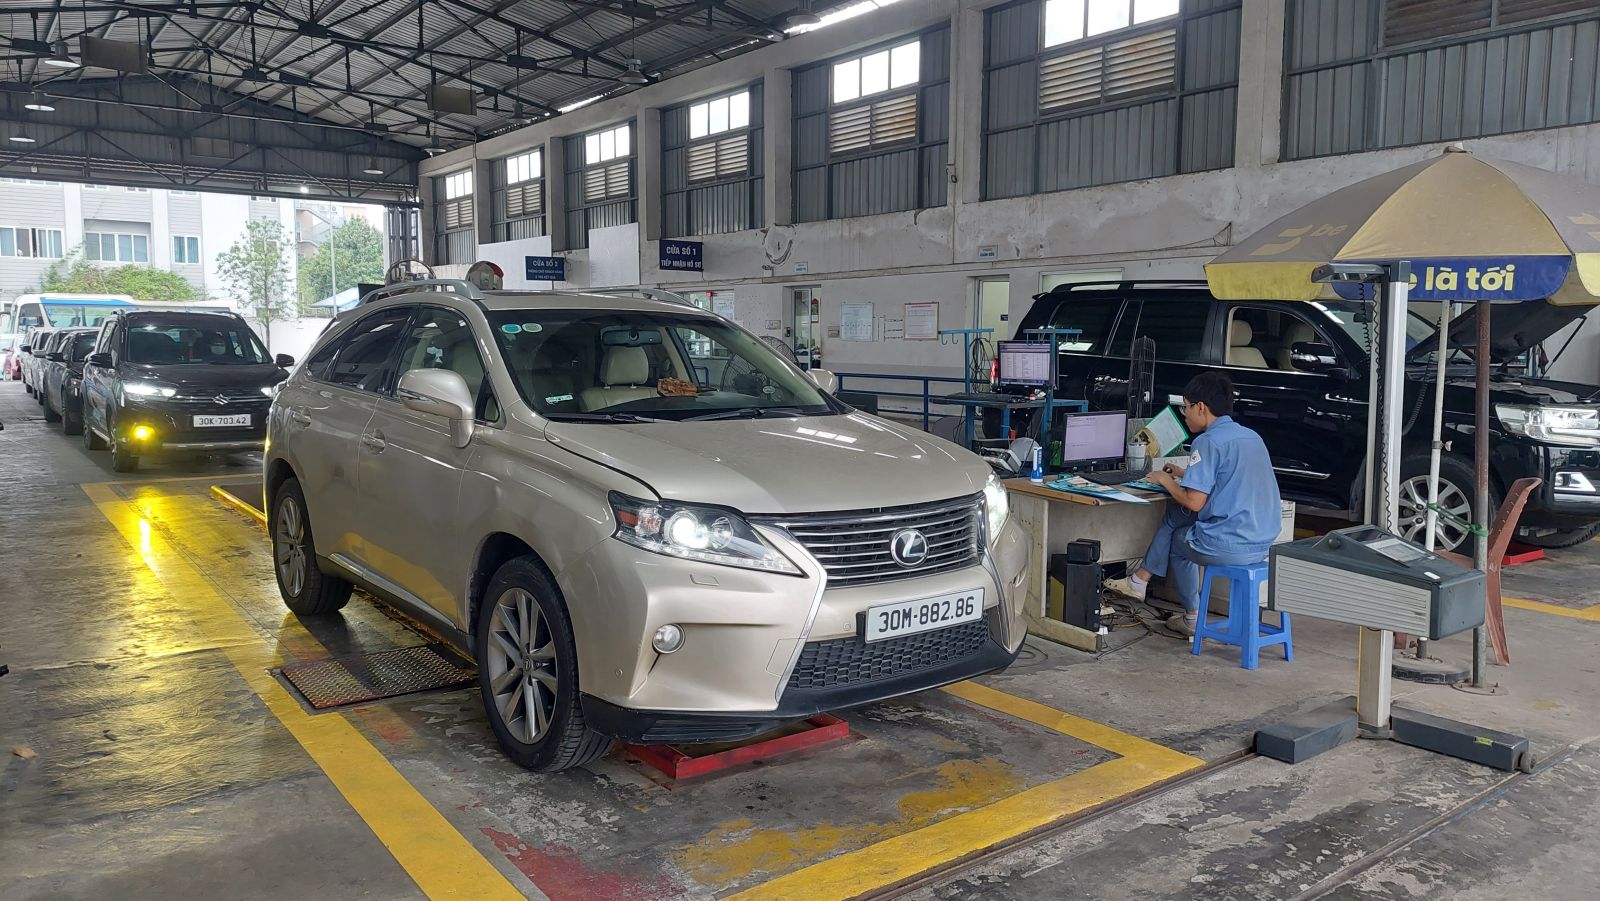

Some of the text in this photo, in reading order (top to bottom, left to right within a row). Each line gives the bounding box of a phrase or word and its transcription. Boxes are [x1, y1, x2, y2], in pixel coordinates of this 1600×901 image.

[682, 245, 691, 256] SỐ
[1425, 266, 1459, 291] là
[1465, 264, 1516, 291] tới
[878, 595, 976, 633] 30M-882.86
